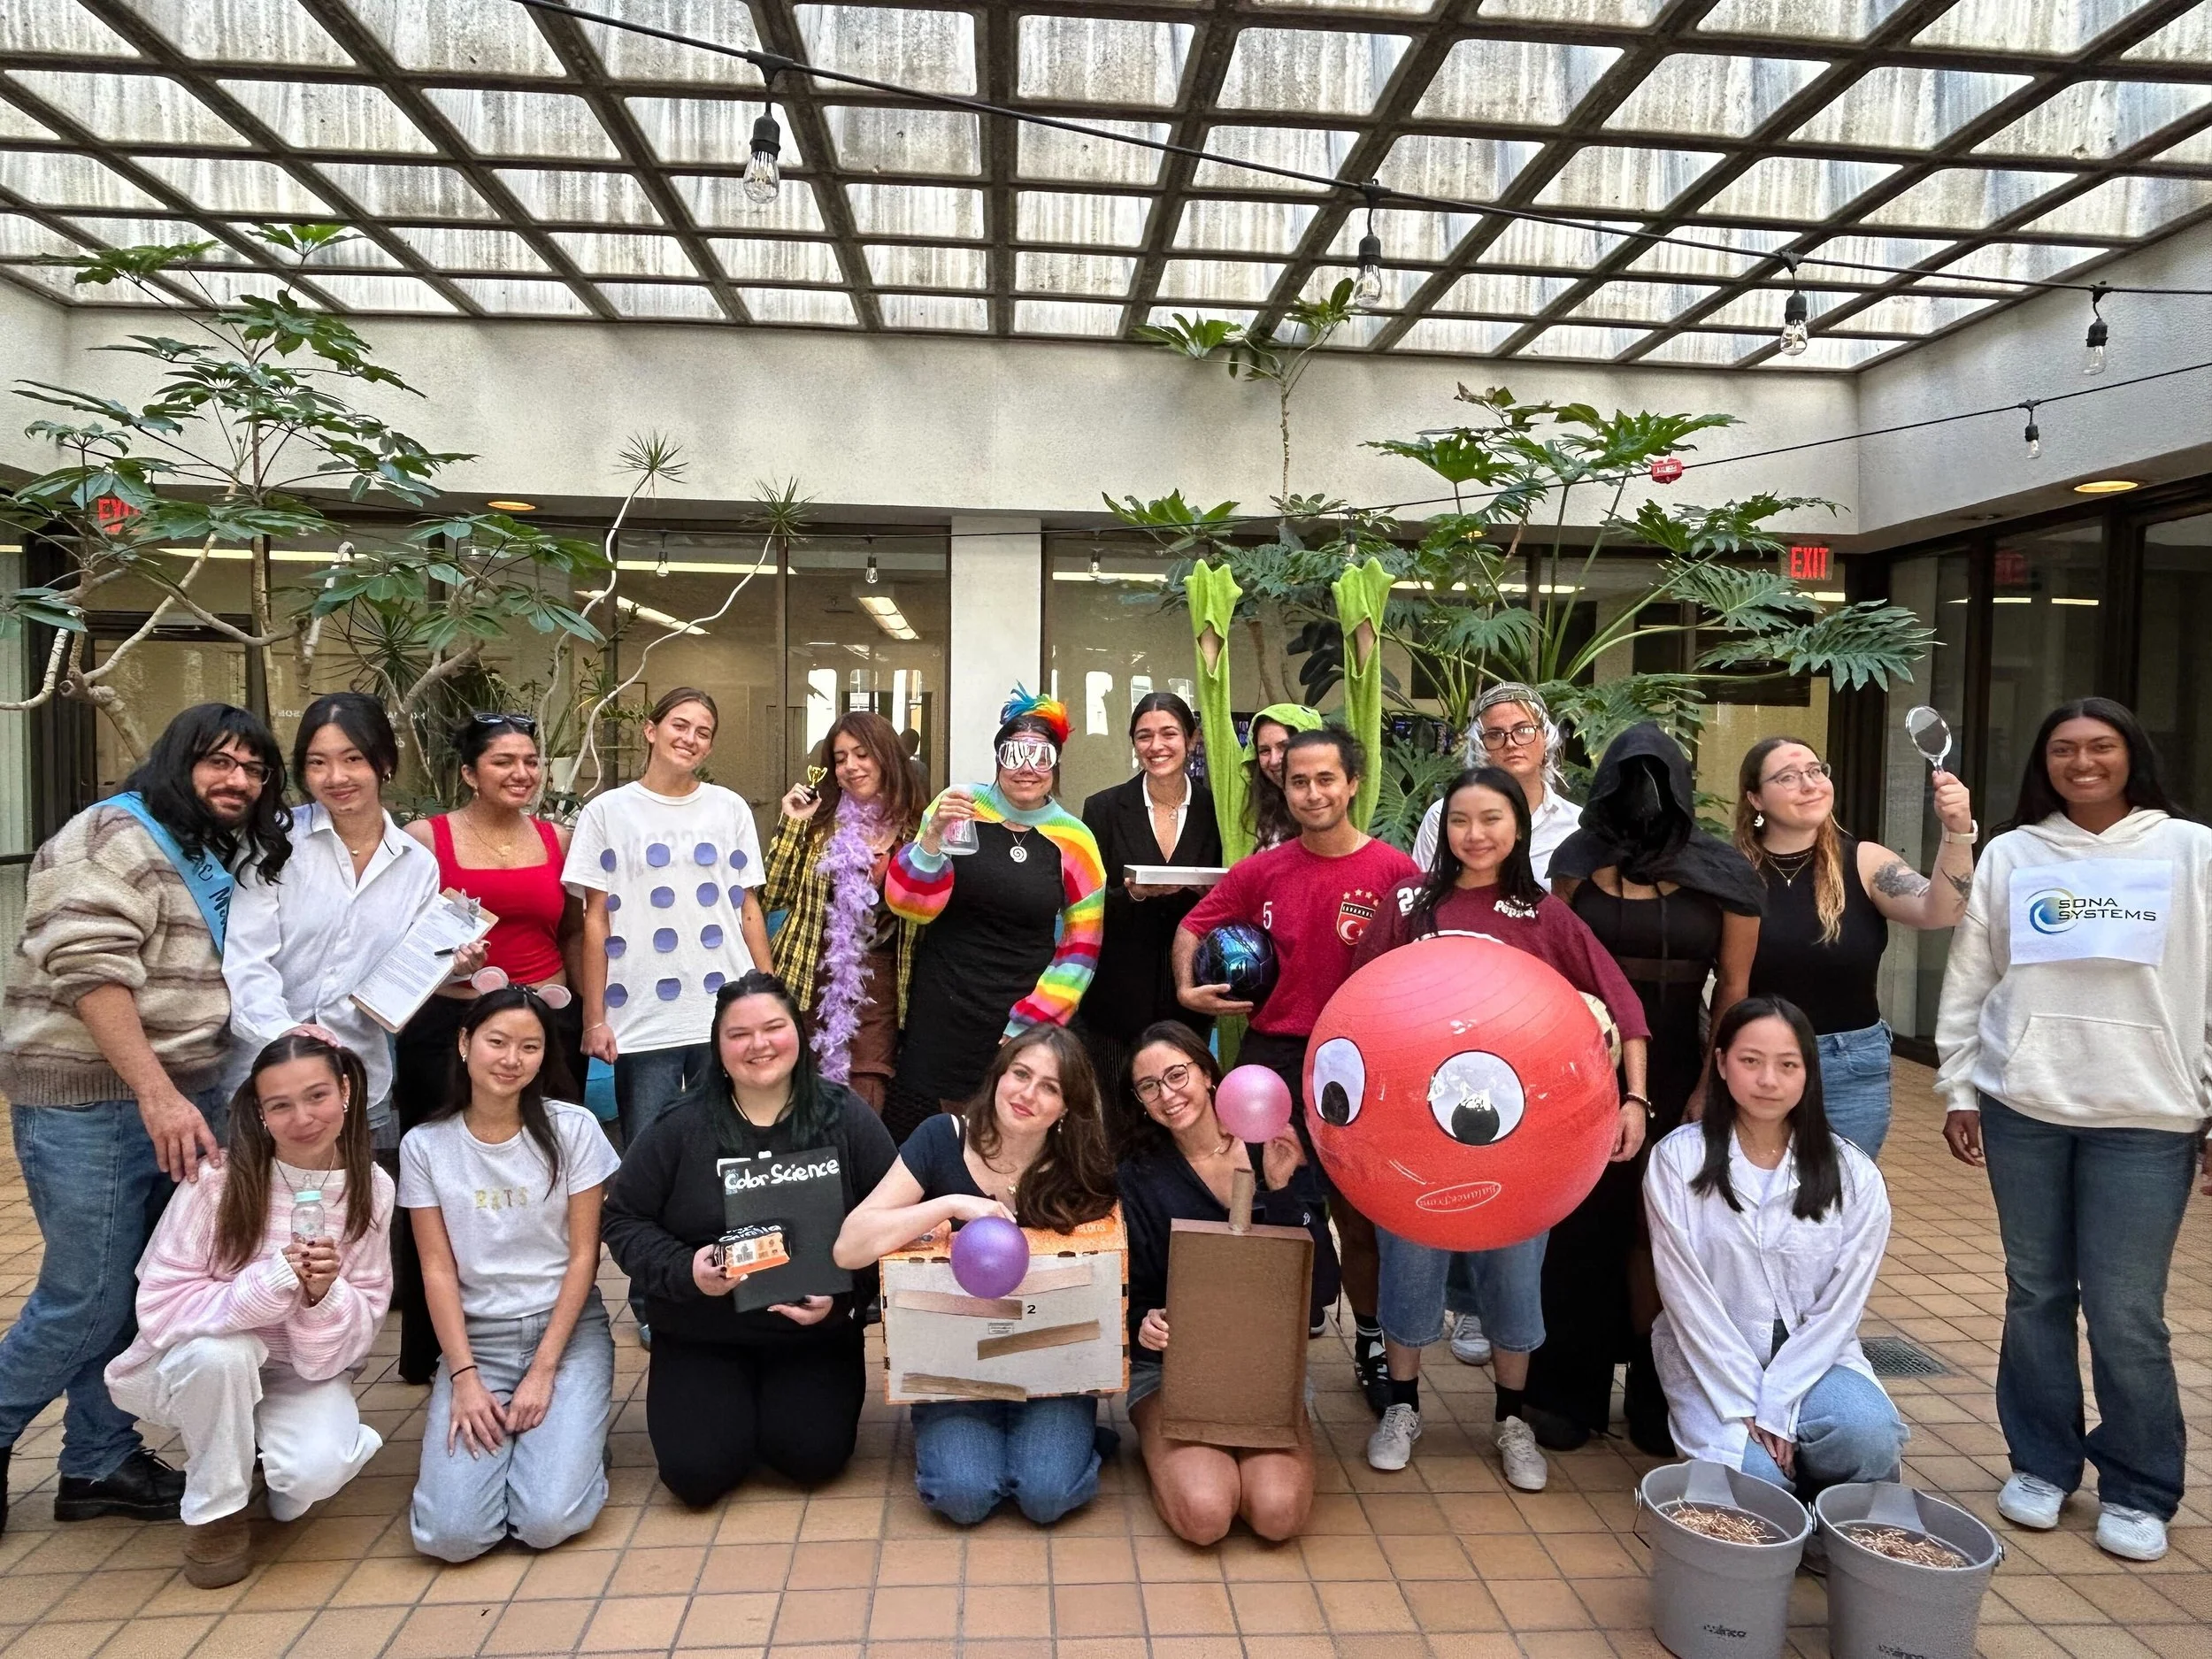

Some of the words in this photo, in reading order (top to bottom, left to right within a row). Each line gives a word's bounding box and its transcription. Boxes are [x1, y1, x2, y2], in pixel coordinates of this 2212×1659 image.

[1791, 546, 1829, 580] EXIT
[2058, 898, 2118, 910] SONA
[1263, 901, 1273, 930] 5
[2058, 909, 2157, 922] SYSTEMS
[724, 1168, 770, 1190] Color
[770, 1158, 840, 1185] Science
[1026, 1304, 1036, 1315] 2
